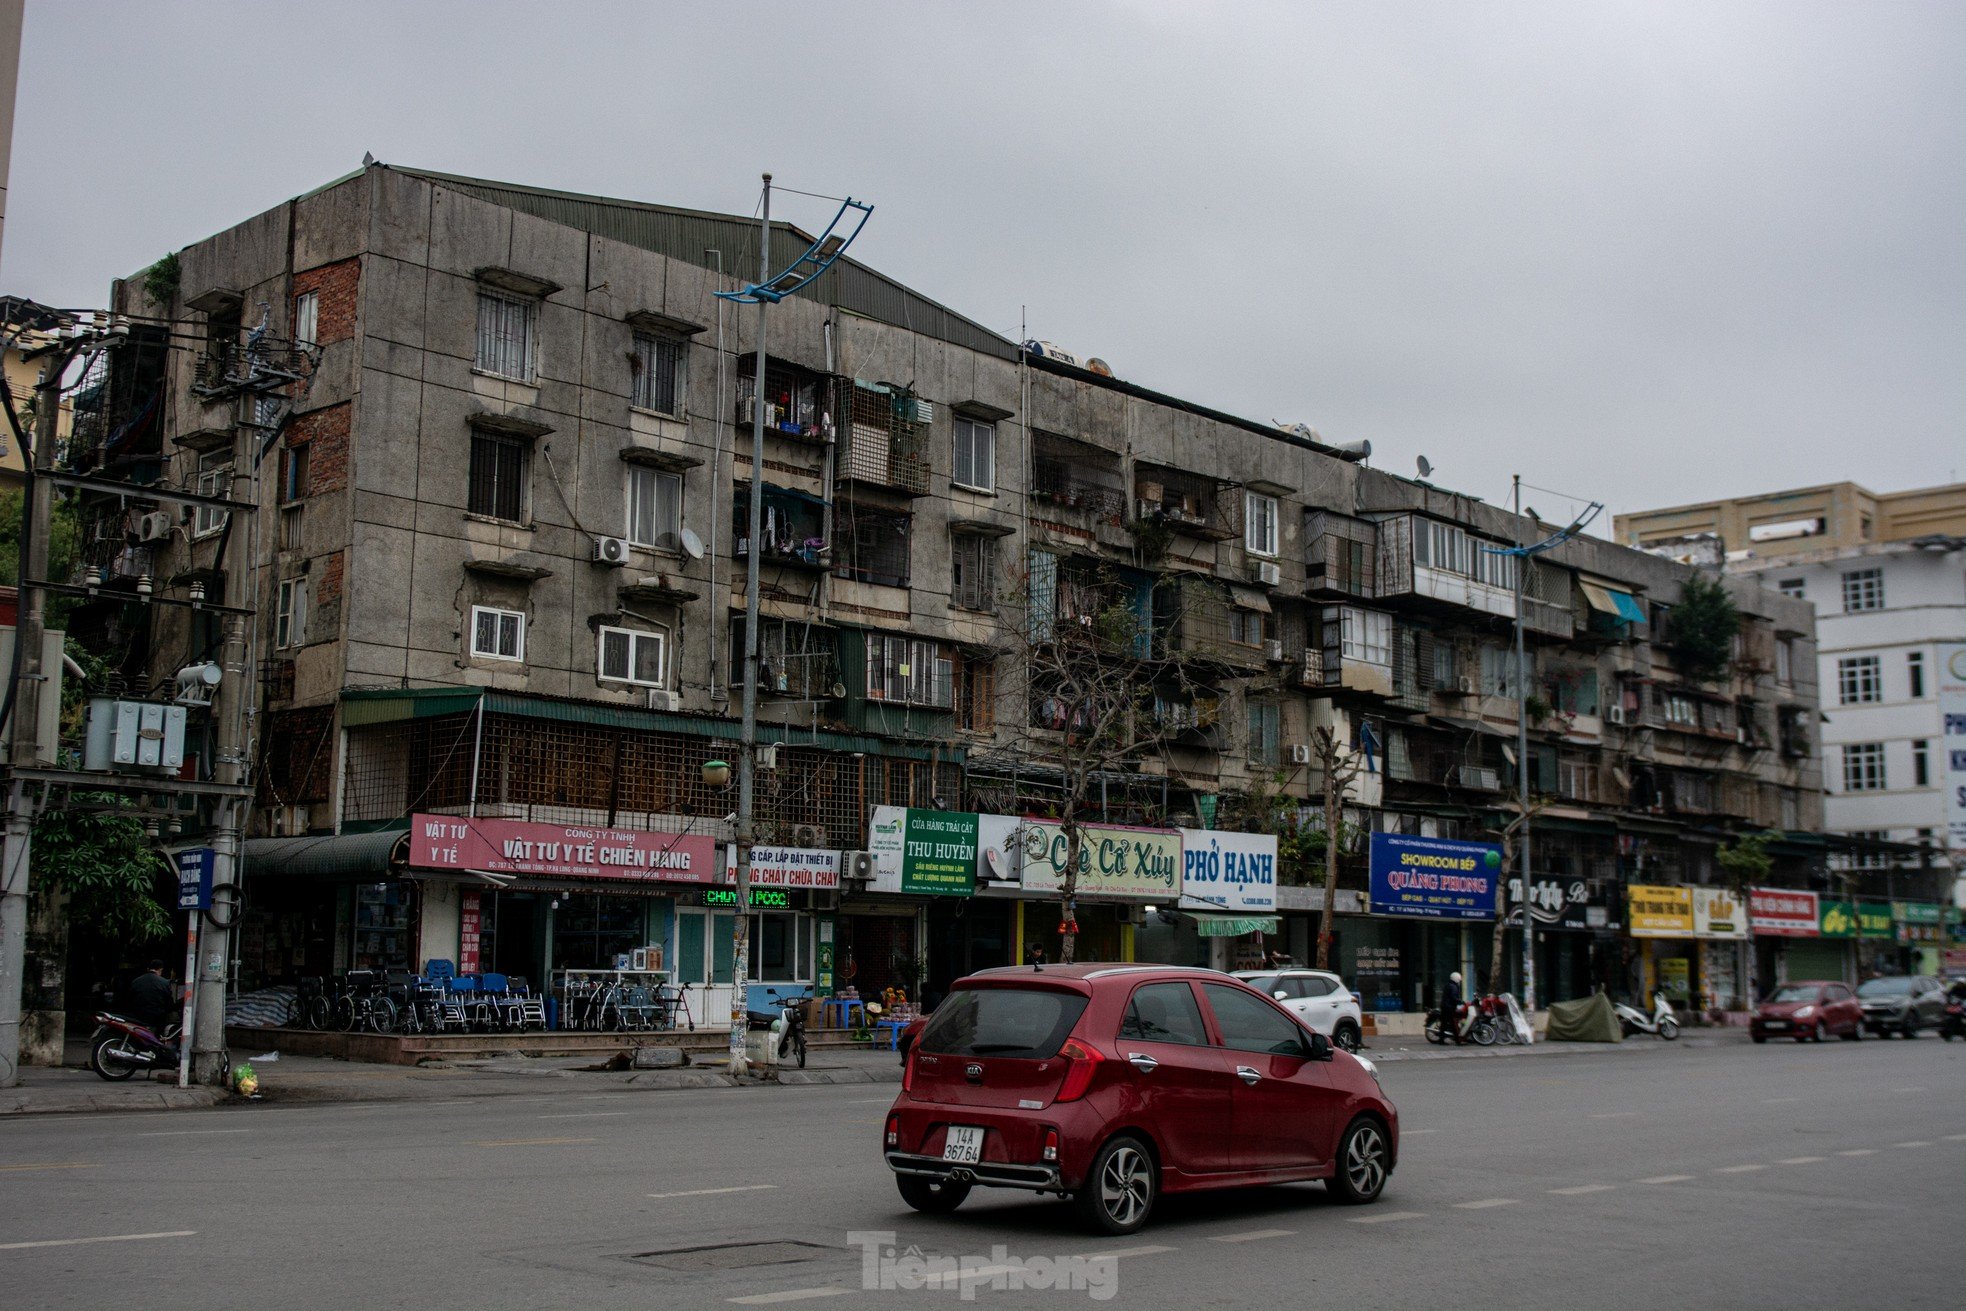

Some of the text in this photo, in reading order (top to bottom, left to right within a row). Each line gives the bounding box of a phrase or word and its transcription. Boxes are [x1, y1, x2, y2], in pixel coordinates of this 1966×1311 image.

[425, 820, 468, 839] VẬT TƯ
[912, 816, 974, 834] CỬA HÀNG TRÁI CÂY
[565, 827, 636, 842] CÔNG TY TNHH
[431, 846, 458, 864] Y TẾ
[503, 836, 532, 863] VẬT
[536, 841, 560, 862] TƯ
[562, 844, 573, 862] Y
[576, 840, 596, 864] TẾ
[599, 842, 645, 867] CHIẾN
[907, 836, 974, 860] THU HUYỀN
[758, 849, 774, 864] CẤP,
[790, 852, 804, 866] ĐẶT
[806, 852, 824, 865] THIẾT
[826, 855, 833, 867] BỊ
[1051, 834, 1176, 888] Cè Cổ Xúy
[1184, 838, 1272, 892] PHỞ HẠNH
[1400, 852, 1477, 871] SHOWROOM BẾP
[728, 866, 839, 887] PHNG CHÁY CHỮA CHÁY
[1388, 868, 1488, 894] QUẢNG PHONG
[707, 890, 753, 905] CHUYN
[967, 1066, 979, 1075] KIA
[957, 1128, 974, 1145] 14A
[945, 1145, 978, 1161] 367.64
